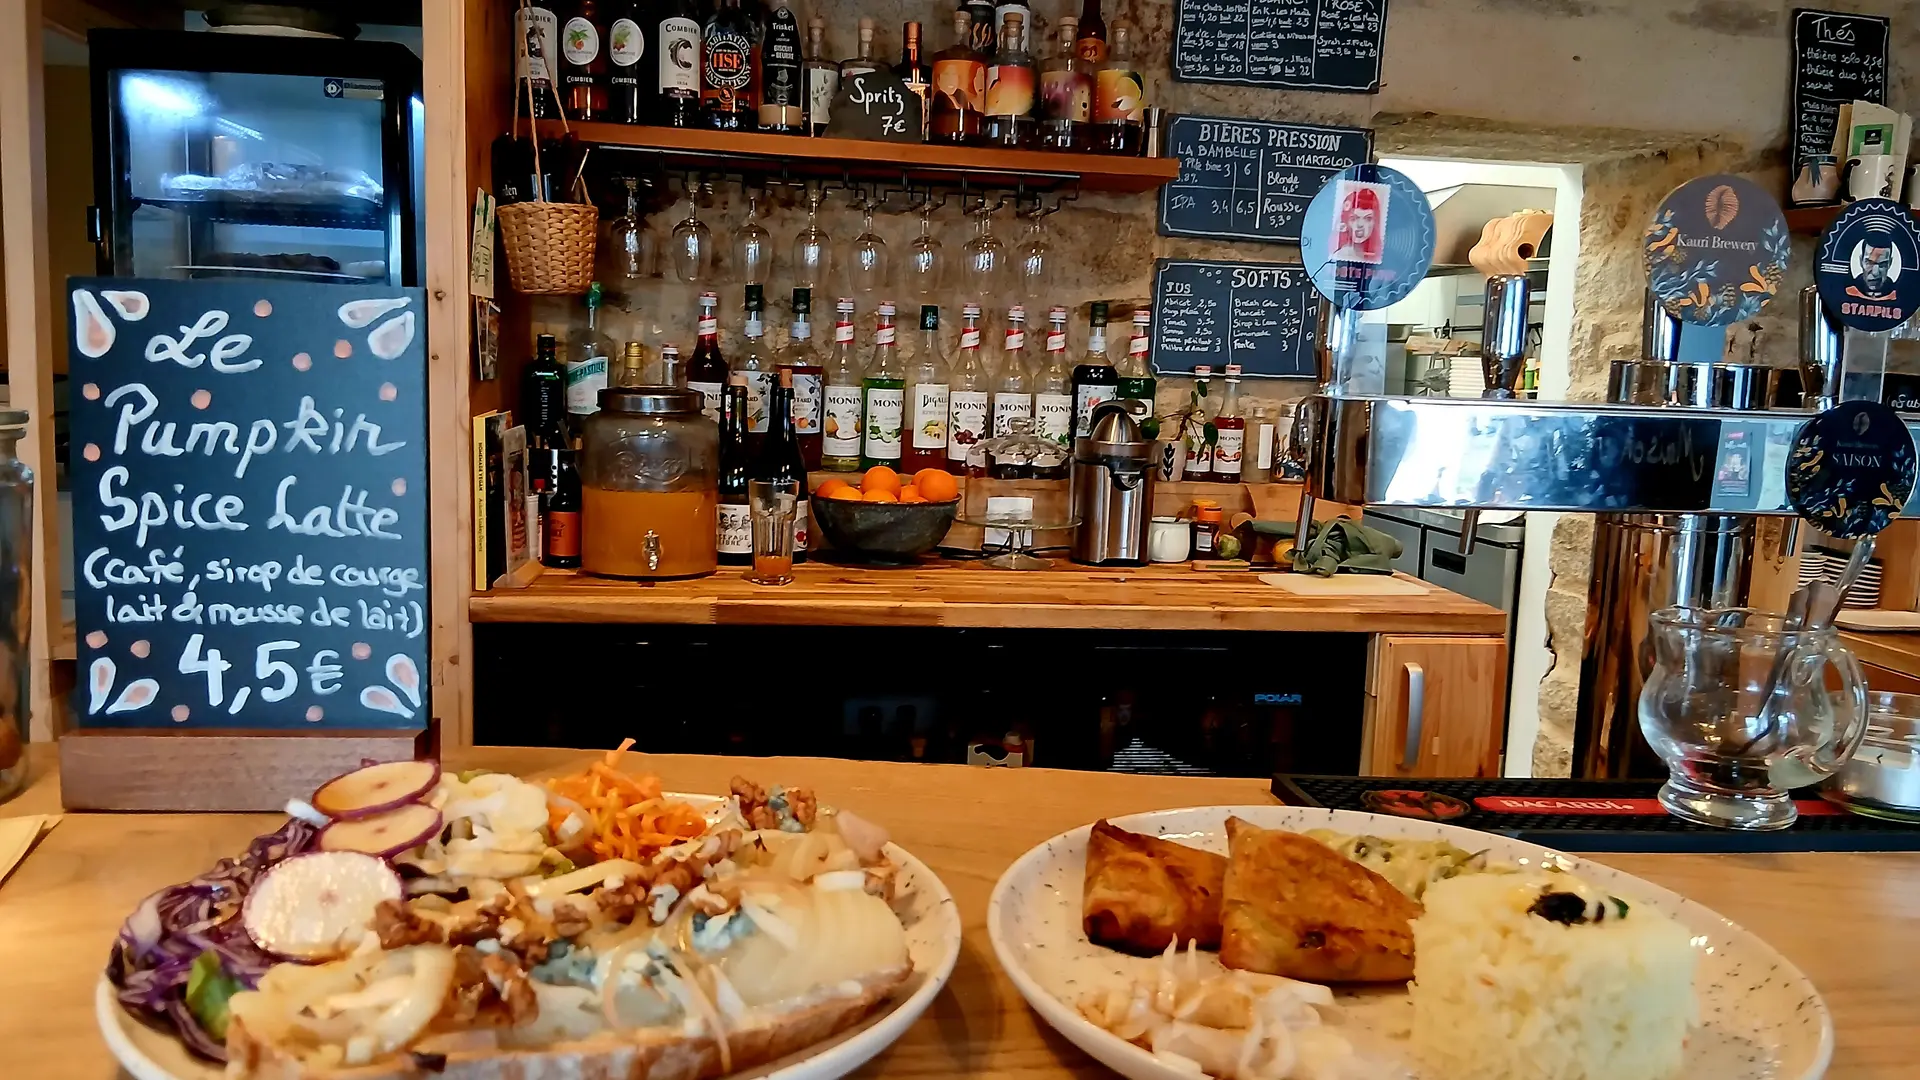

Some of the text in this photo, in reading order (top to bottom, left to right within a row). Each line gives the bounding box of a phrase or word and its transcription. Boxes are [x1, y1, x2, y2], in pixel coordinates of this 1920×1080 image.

[1233, 14, 1245, 22] 22
[1296, 17, 1309, 28] 25
[666, 23, 697, 34] COMBIER
[1367, 22, 1378, 32] 23
[1811, 16, 1855, 41] Thés
[1232, 41, 1245, 49] 18
[1271, 39, 1279, 49] 3
[1369, 48, 1377, 57] 20
[1841, 52, 1861, 64] solo
[713, 53, 742, 69] HSE
[1229, 64, 1242, 73] 20
[1300, 65, 1310, 76] 22
[1839, 69, 1857, 80] duo
[849, 77, 904, 115] Spritz
[881, 115, 906, 136] 7€
[1267, 128, 1342, 152] PRESSION
[1177, 141, 1257, 159] LA BAMBELLE
[1223, 163, 1231, 177] 3
[1244, 163, 1252, 175] 6
[1267, 171, 1300, 186] Blonde
[1171, 193, 1196, 210] IPA
[1236, 200, 1256, 215] 6,5
[1263, 198, 1303, 214] Rousse
[1676, 233, 1759, 251] Kauri Brewery
[1231, 268, 1291, 289] SOFTS
[1165, 281, 1191, 294] JUS
[1164, 298, 1217, 309] Abricot 2,50
[1282, 298, 1291, 307] 3
[1204, 308, 1212, 316] 4
[1279, 308, 1298, 317] 1,50
[1841, 302, 1902, 320] STARPILS
[1232, 319, 1253, 329] Sirop
[1233, 329, 1271, 337] Limonade
[144, 310, 264, 374] Le
[1215, 337, 1222, 346] 3
[1233, 338, 1288, 352] Fanta 3
[104, 383, 407, 479] Pumpkin
[1832, 453, 1882, 468] SAISON
[99, 466, 249, 548] Spice
[267, 474, 402, 540] Latte
[83, 545, 424, 598] (café, sirop de courge
[106, 594, 168, 623] lait
[208, 603, 305, 626] mousse
[310, 597, 351, 627] de
[358, 599, 424, 639] lait)
[1254, 693, 1302, 703] POLAR
[1500, 799, 1623, 810] BACARDI
